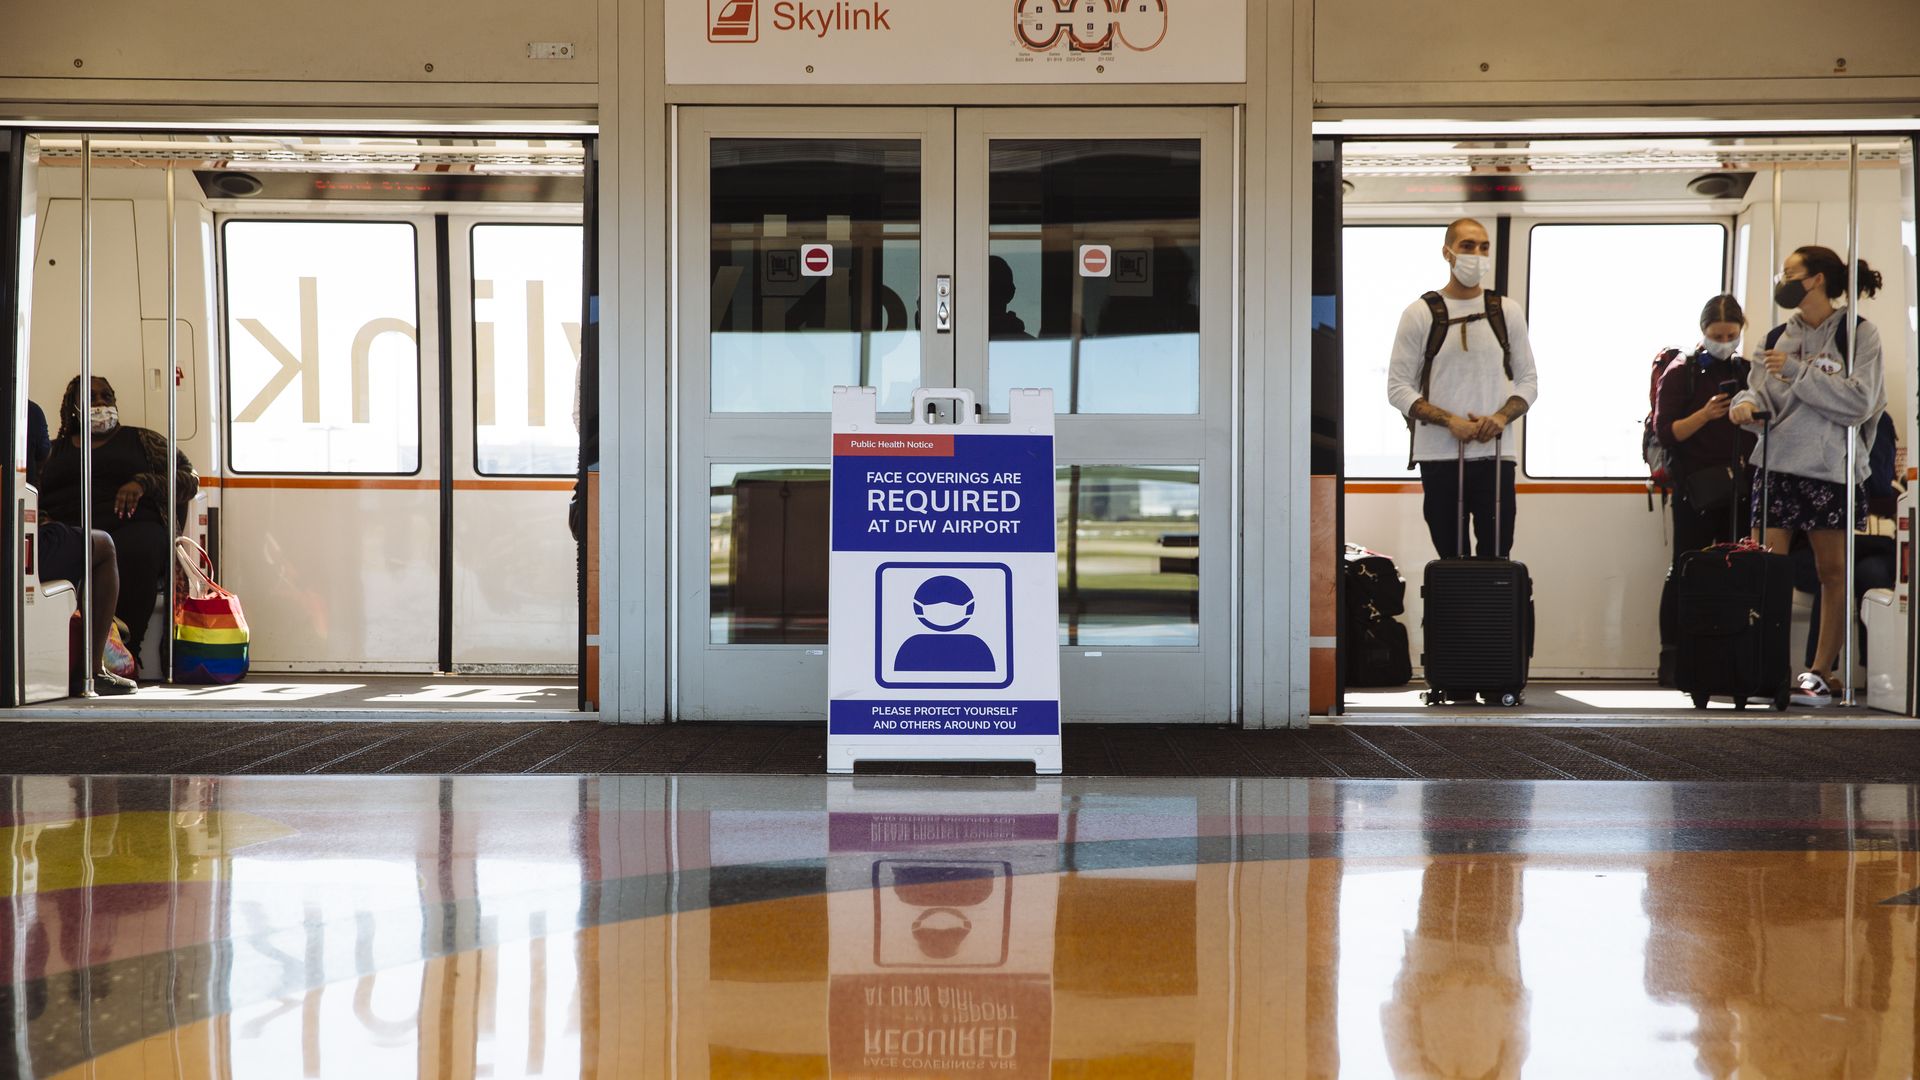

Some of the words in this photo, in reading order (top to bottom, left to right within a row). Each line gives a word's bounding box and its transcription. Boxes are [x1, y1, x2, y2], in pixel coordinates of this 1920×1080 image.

[773, 1, 891, 38] Skylink
[850, 440, 876, 449] Public
[877, 440, 905, 449] Health
[906, 440, 934, 449] Notice
[866, 471, 903, 484] FACE
[906, 471, 989, 484] COVERINGS
[992, 472, 1022, 484] ARE
[867, 489, 1021, 515] REQUIRED
[867, 519, 890, 533] AT
[895, 519, 937, 533] DFW
[941, 519, 1021, 534] AIRPORT
[871, 706, 912, 716] PLEASE
[913, 706, 962, 716] PROTECT
[963, 706, 1018, 716] YOURSELF
[873, 720, 897, 730] AND
[899, 720, 942, 730] OTHERS
[943, 720, 991, 730] AROUND
[993, 720, 1017, 730] YOU
